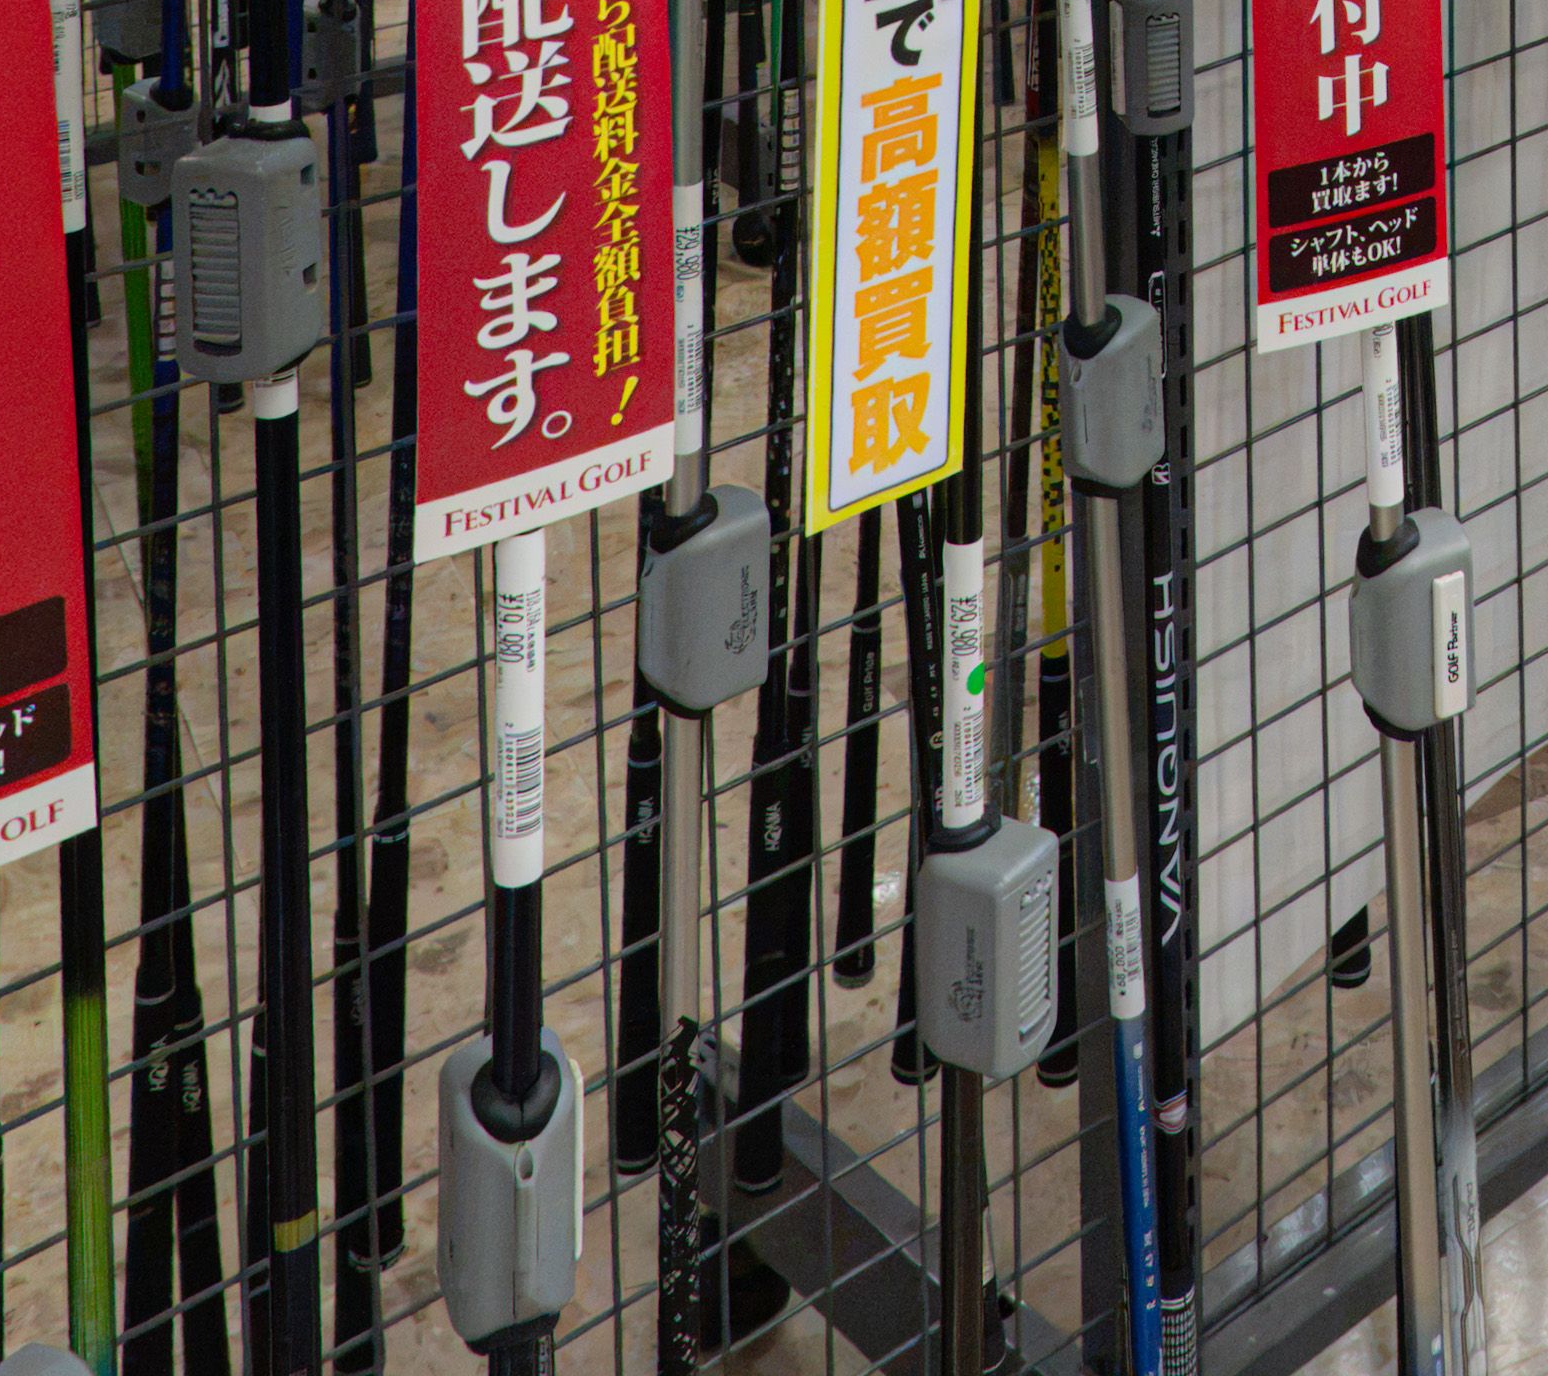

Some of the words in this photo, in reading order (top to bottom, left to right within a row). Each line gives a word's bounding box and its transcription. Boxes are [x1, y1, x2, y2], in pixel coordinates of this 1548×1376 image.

[1277, 290, 1374, 337] FESTIVAL
[1377, 277, 1434, 312] GOLF
[442, 474, 574, 539] FESTIVAL
[578, 450, 652, 495] GOLF
[1153, 570, 1181, 945] VANQUISH
